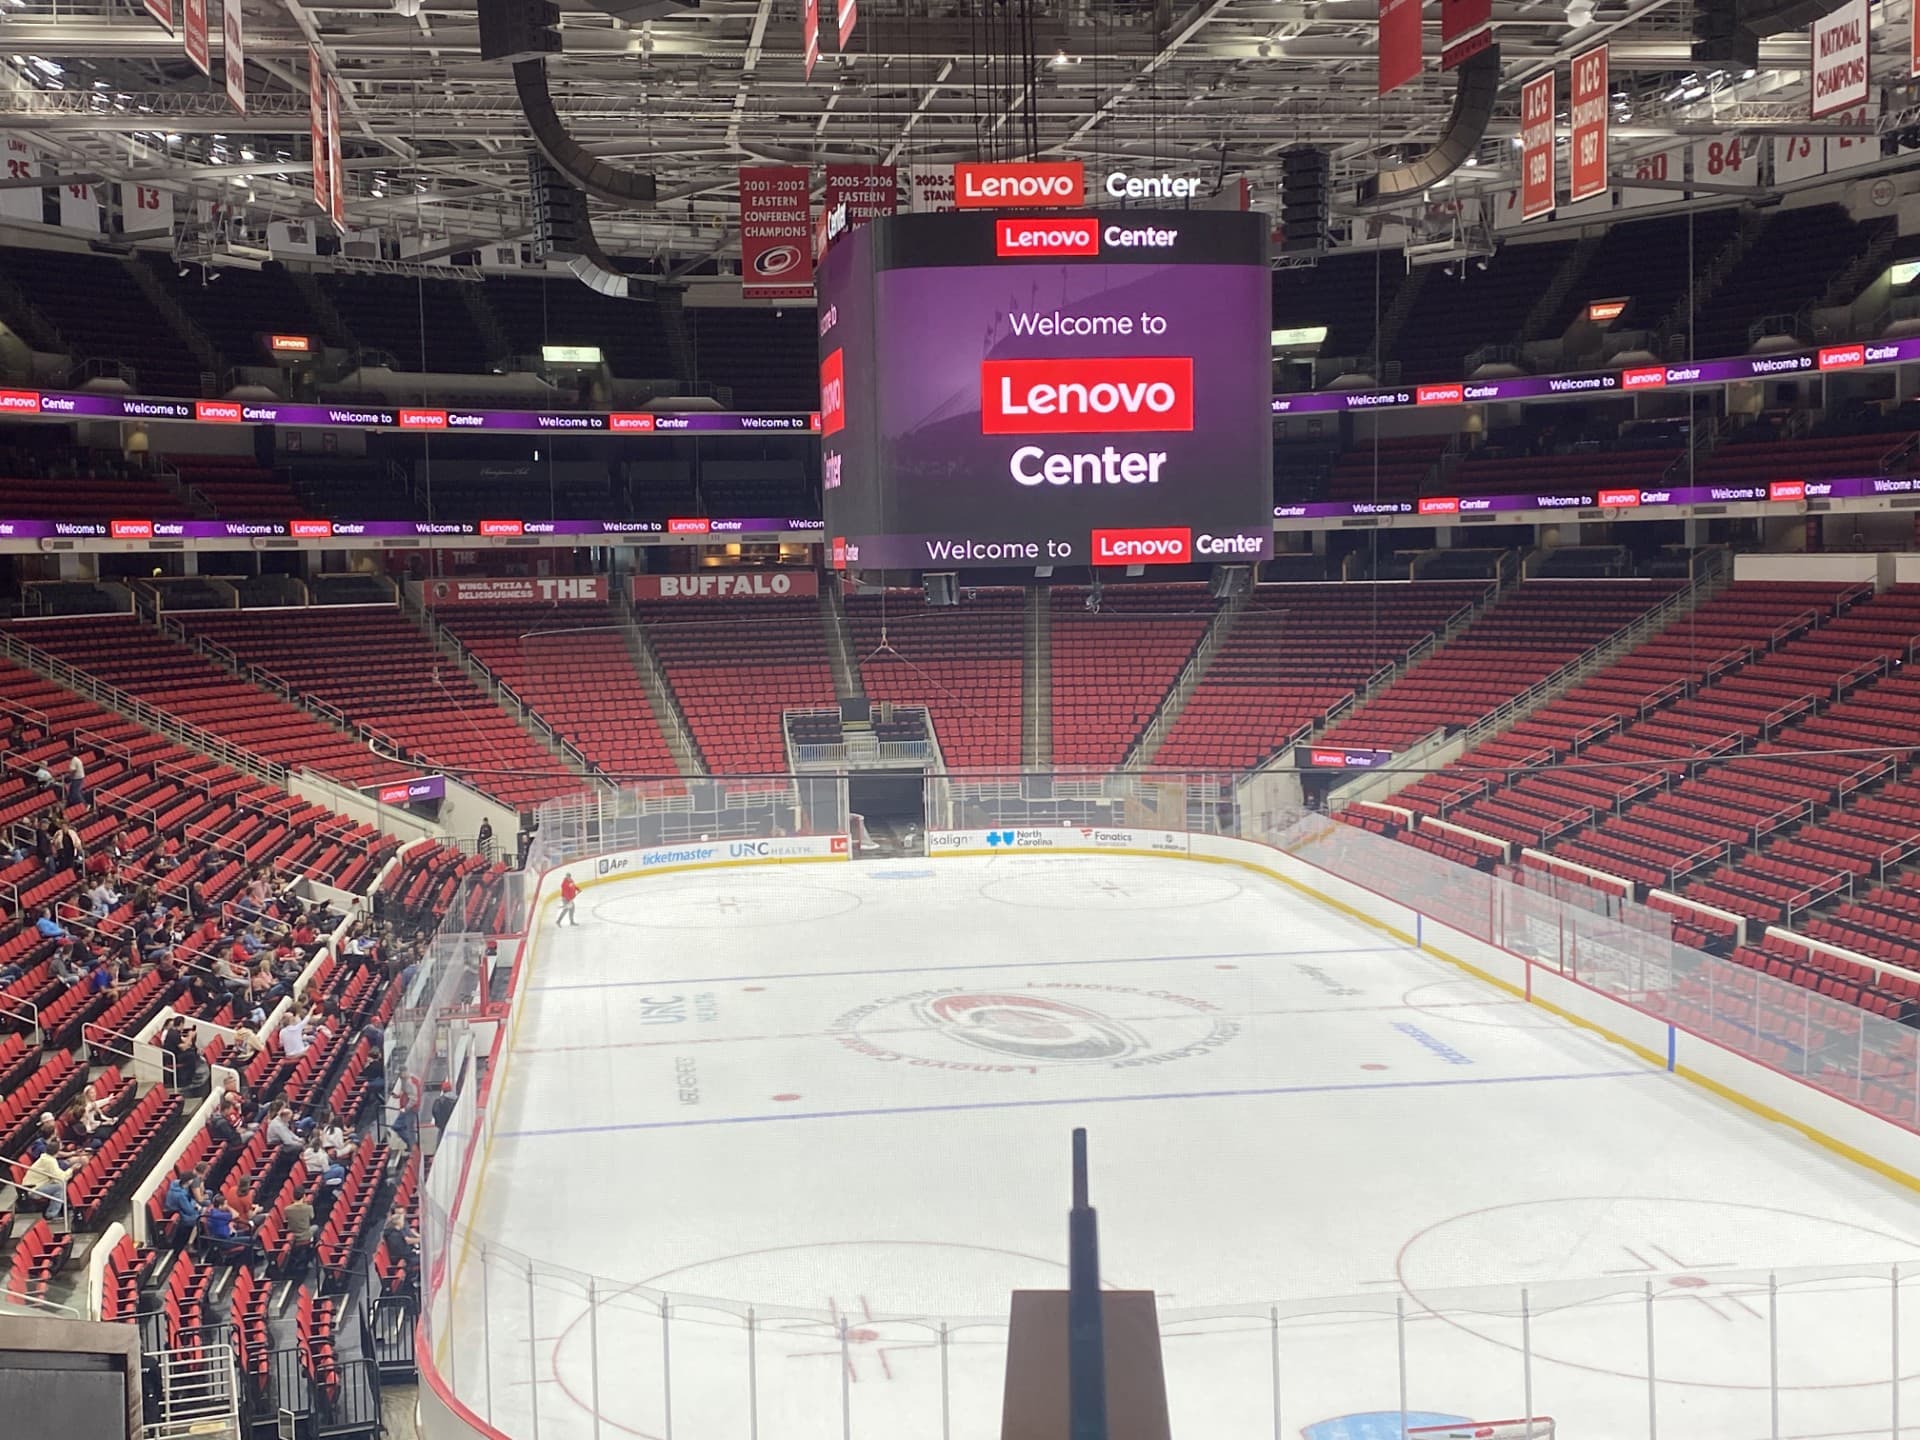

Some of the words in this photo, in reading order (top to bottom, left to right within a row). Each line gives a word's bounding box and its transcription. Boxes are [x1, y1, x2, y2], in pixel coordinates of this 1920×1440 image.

[1820, 19, 1861, 59] NATIONAL
[1580, 58, 1600, 97] ACC
[1816, 56, 1864, 98] CHAMPIONS
[1529, 83, 1548, 121] ACC
[1708, 138, 1742, 175] 84
[744, 181, 805, 191] 2001-2002
[830, 176, 893, 188] 2005-2006
[915, 176, 954, 187] 2005-2
[966, 173, 1074, 197] Lenovo
[1106, 173, 1202, 198] Center
[136, 185, 160, 210] 13
[752, 196, 798, 207] EASTERN
[838, 191, 885, 203] EASTERN
[923, 190, 954, 201] STAN
[744, 211, 806, 222] CONFERENCE
[744, 227, 807, 237] CHAMPIONS
[1005, 226, 1089, 247] Lenovo
[1104, 226, 1178, 248] Center
[1009, 311, 1134, 336] Welcome
[1141, 311, 1168, 335] to
[275, 338, 305, 348] Lenovo
[1753, 358, 1798, 373] Welcome
[1800, 356, 1812, 368] to
[1822, 351, 1861, 365] Lenovo
[1865, 345, 1899, 360] Center
[1550, 377, 1600, 391] Welcome
[1601, 376, 1615, 388] to
[1625, 372, 1662, 385] Lenovo
[1666, 368, 1701, 381] Center
[1001, 376, 1176, 415] Lenovo
[1346, 393, 1394, 407] Welcome
[1397, 391, 1410, 403] to
[1420, 389, 1459, 401] Lenovo
[1463, 386, 1499, 399] Center
[41, 398, 75, 411] Center
[123, 402, 174, 416] Welcome
[176, 405, 189, 416] to
[200, 406, 238, 419] Lenovo
[242, 407, 277, 420] Center
[329, 410, 379, 423] Welcome
[380, 411, 393, 423] to
[403, 413, 443, 425] Lenovo
[448, 413, 484, 426] Center
[538, 416, 588, 428] Welcome
[589, 417, 603, 428] to
[612, 418, 651, 428] Lenovo
[655, 417, 689, 428] Center
[741, 417, 789, 428] Welcome
[791, 418, 804, 428] to
[1009, 445, 1168, 486] Center
[1711, 487, 1754, 499] Welcome
[1755, 487, 1766, 497] to
[1772, 484, 1802, 497] Lenovo
[1804, 482, 1832, 495] Center
[1874, 480, 1911, 492] Welcome
[1352, 503, 1397, 513] Welcome
[1400, 502, 1412, 512] to
[1421, 500, 1455, 511] Lenovo
[1460, 498, 1490, 510] Center
[1537, 495, 1580, 507] Welcome
[1581, 495, 1592, 505] to
[1601, 493, 1637, 504] Lenovo
[1640, 491, 1670, 503] Center
[1273, 506, 1306, 517] Center
[56, 523, 95, 534] Welcome
[96, 524, 106, 534] to
[115, 524, 149, 534] Lenovo
[153, 524, 184, 534] Center
[226, 523, 269, 534] Welcome
[271, 524, 285, 534] to
[294, 523, 328, 534] Lenovo
[332, 523, 364, 534] Center
[416, 523, 460, 533] Welcome
[461, 523, 473, 533] to
[484, 522, 520, 533] Lenovo
[523, 522, 554, 533] Center
[603, 521, 648, 532] Welcome
[650, 521, 662, 531] to
[671, 521, 706, 531] Lenovo
[711, 521, 742, 531] Center
[926, 540, 1039, 561] Welcome
[1047, 540, 1072, 559] to
[1101, 537, 1182, 558] Lenovo
[1196, 533, 1264, 555] Center
[458, 583, 490, 592] WINGS,
[493, 582, 523, 591] PIZZA
[524, 582, 532, 591] &
[537, 579, 597, 599] THE
[660, 574, 791, 597] BUFFALO
[458, 591, 533, 600] DELICIOUSNESS
[1345, 755, 1372, 766] Center
[408, 786, 431, 796] Center
[1017, 830, 1043, 840] North
[1095, 831, 1132, 842] Fanatics
[1017, 838, 1054, 847] Carolina
[729, 842, 769, 858] UNC
[642, 848, 713, 866] ticketmaster
